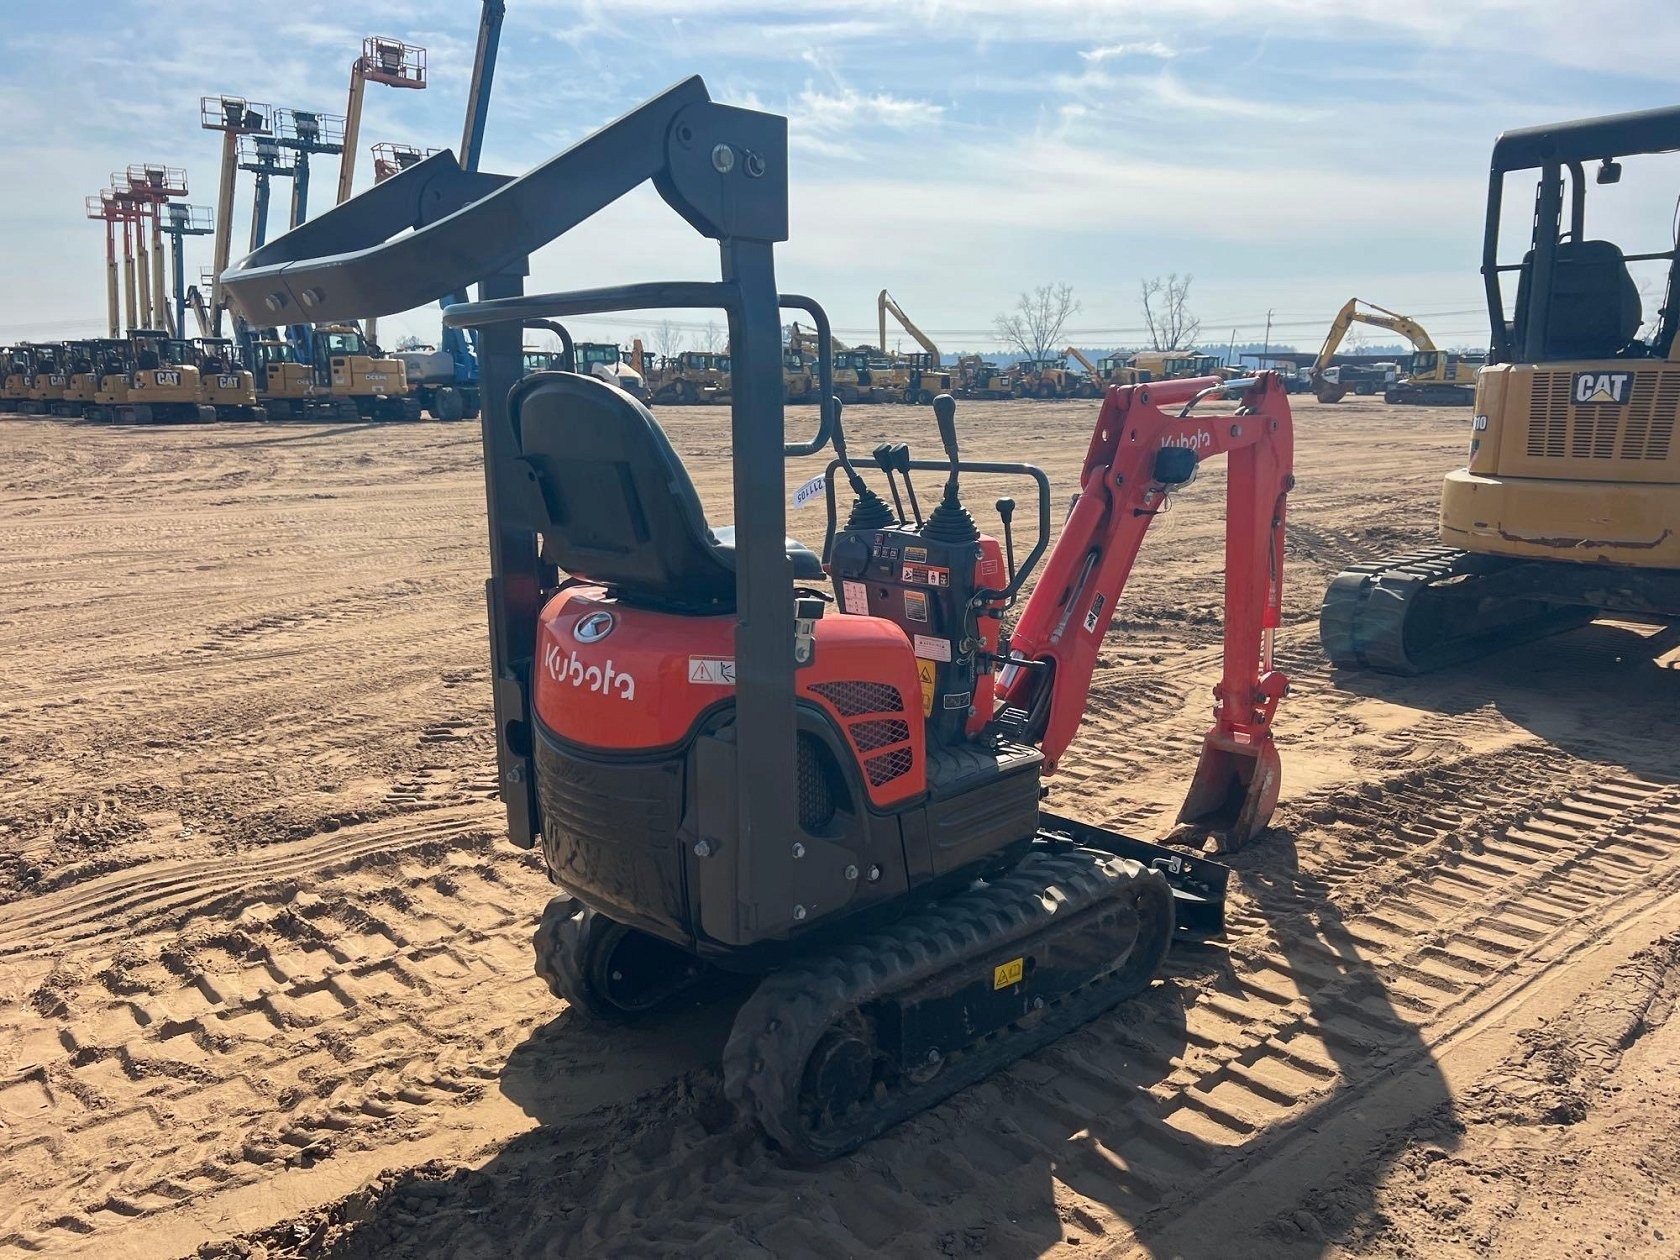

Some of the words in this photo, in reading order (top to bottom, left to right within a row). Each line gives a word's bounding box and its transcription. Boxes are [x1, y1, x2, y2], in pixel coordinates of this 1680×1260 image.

[157, 372, 178, 385] CAT
[220, 377, 239, 388] CAT
[1576, 375, 1627, 401] CAT
[797, 479, 823, 503] 211105
[544, 643, 635, 701] Kubota
